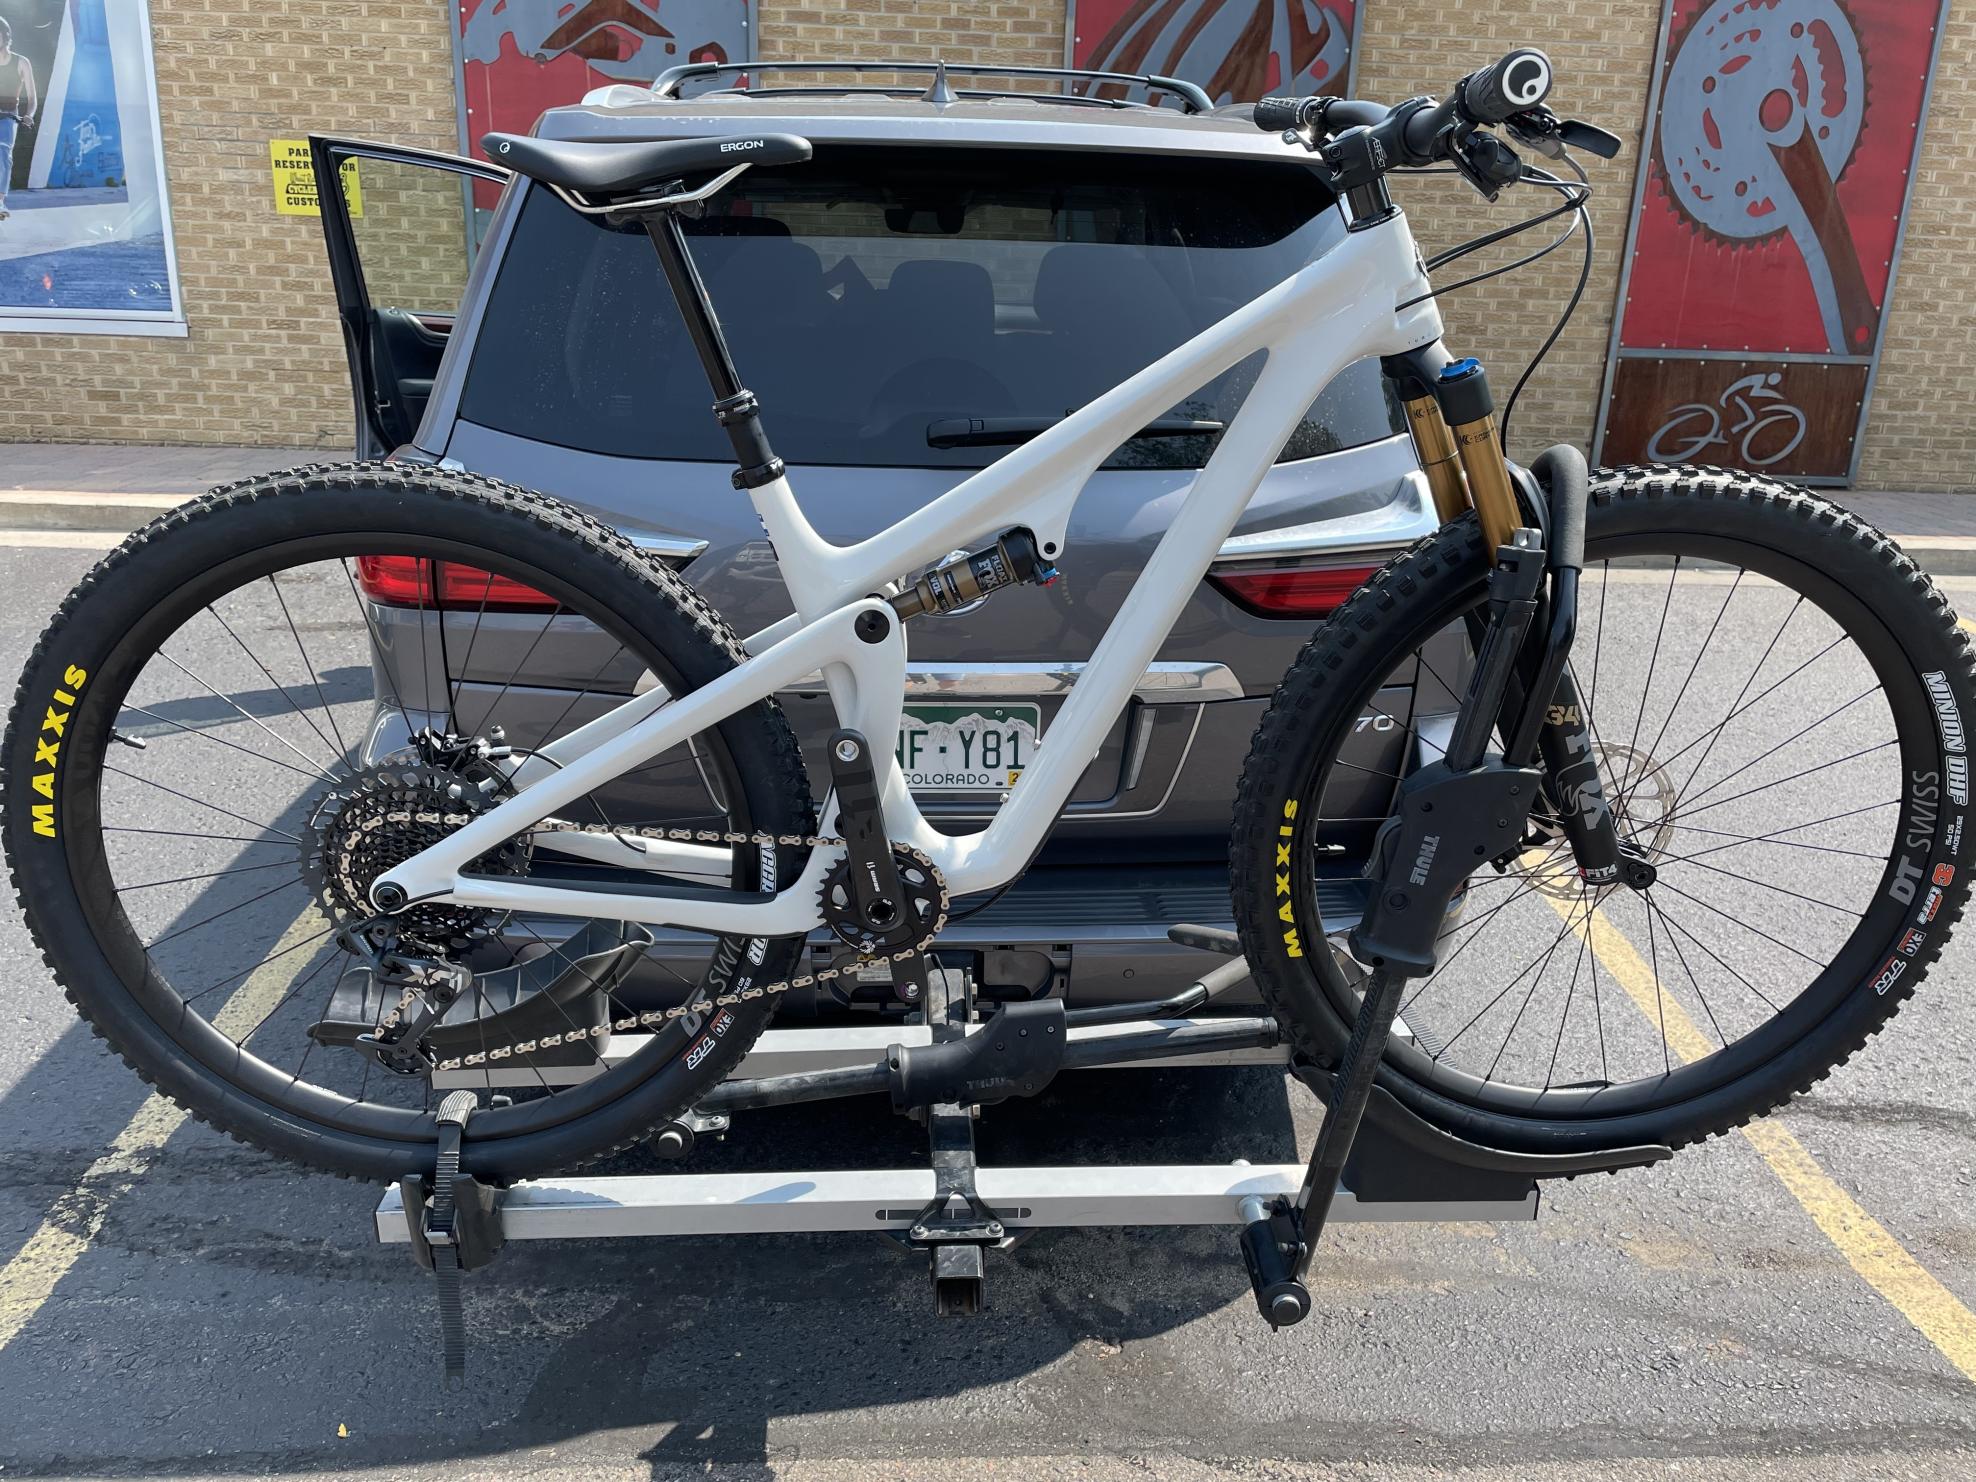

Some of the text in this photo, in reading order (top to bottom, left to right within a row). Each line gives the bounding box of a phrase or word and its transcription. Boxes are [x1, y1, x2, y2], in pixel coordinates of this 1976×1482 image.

[342, 163, 356, 172] OR
[720, 140, 764, 152] ERGON
[32, 664, 87, 838] MAXXIS
[1922, 670, 1968, 806] MINION DHF
[1906, 770, 1940, 853] SWISS
[1276, 799, 1303, 958] MAXXIS
[1409, 835, 1441, 886] THULE
[1889, 855, 1924, 906] DT
[708, 936, 746, 993] SWI
[1875, 959, 1907, 996] TR
[688, 1036, 716, 1070] TR
